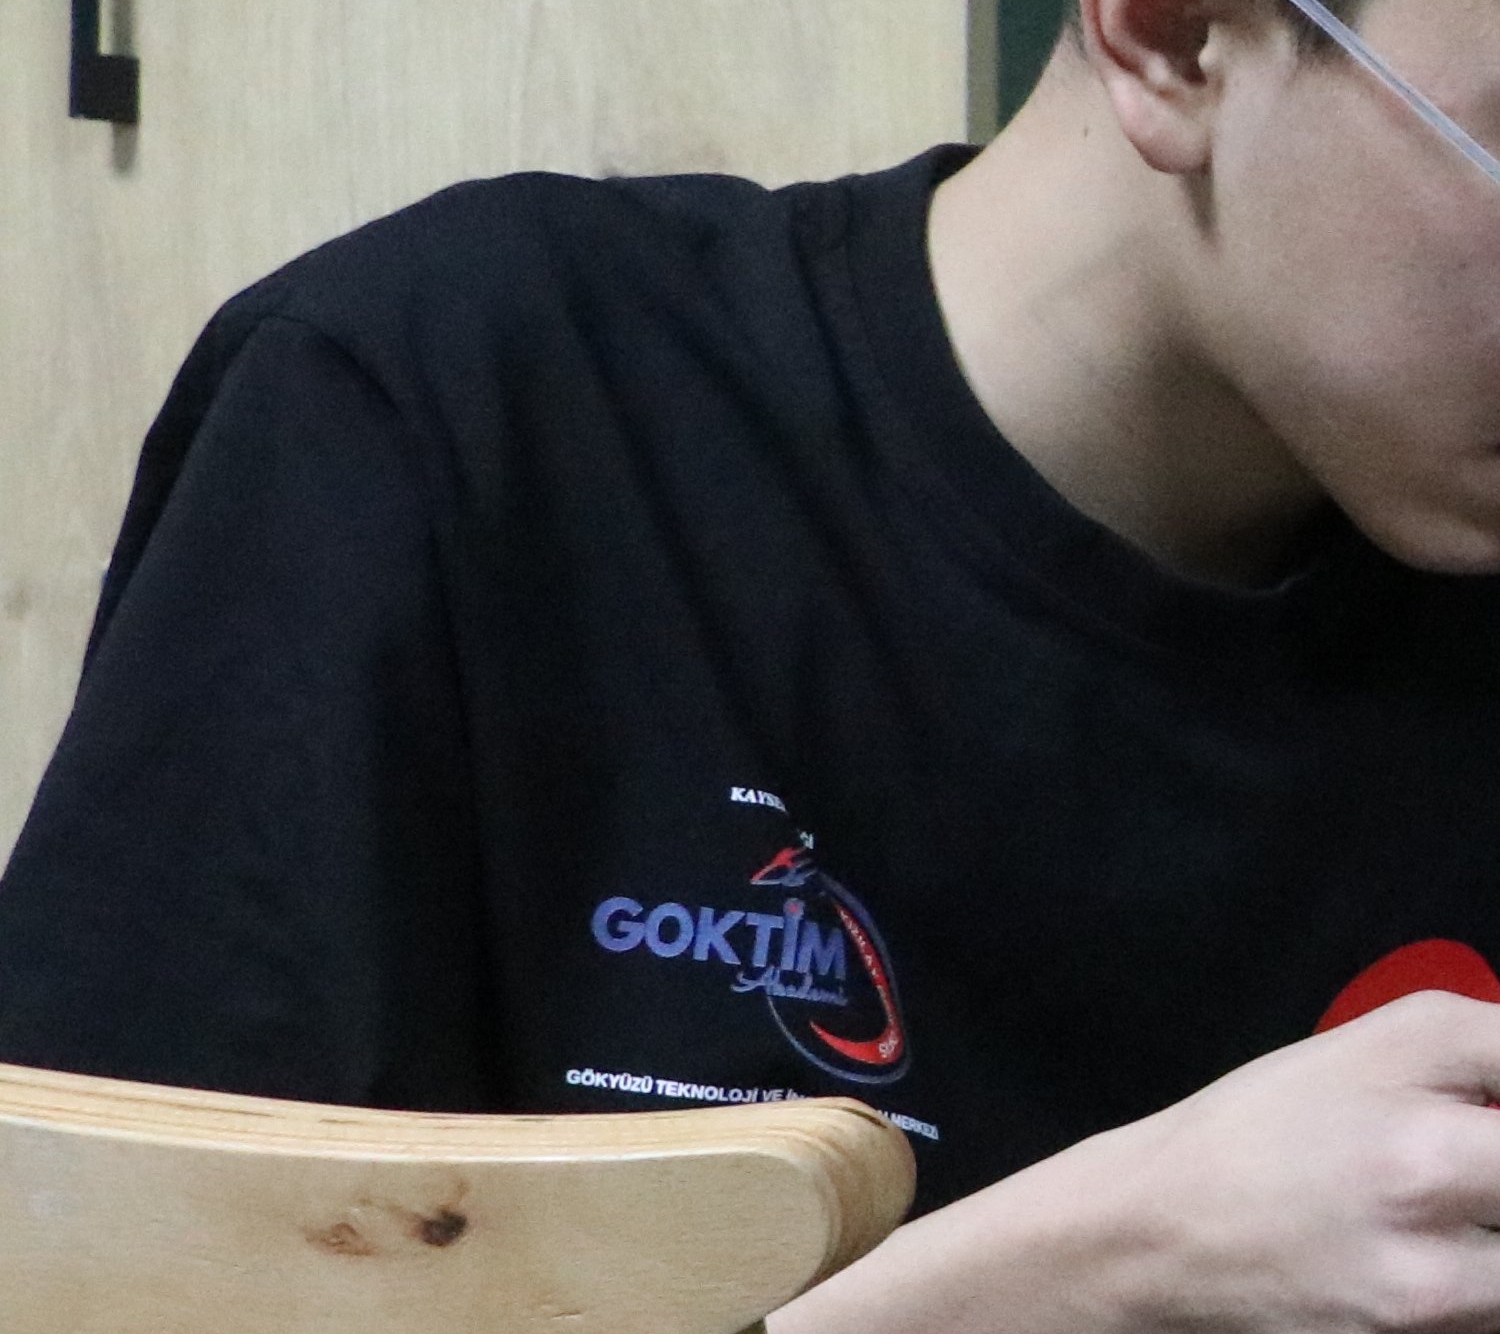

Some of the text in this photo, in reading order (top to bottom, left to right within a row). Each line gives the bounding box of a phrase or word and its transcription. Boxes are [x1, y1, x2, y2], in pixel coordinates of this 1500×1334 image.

[591, 895, 848, 981] GOKTİM
[565, 1067, 653, 1093] GÖKYÜZÜ
[655, 1078, 759, 1104] TEKNOLOJİ
